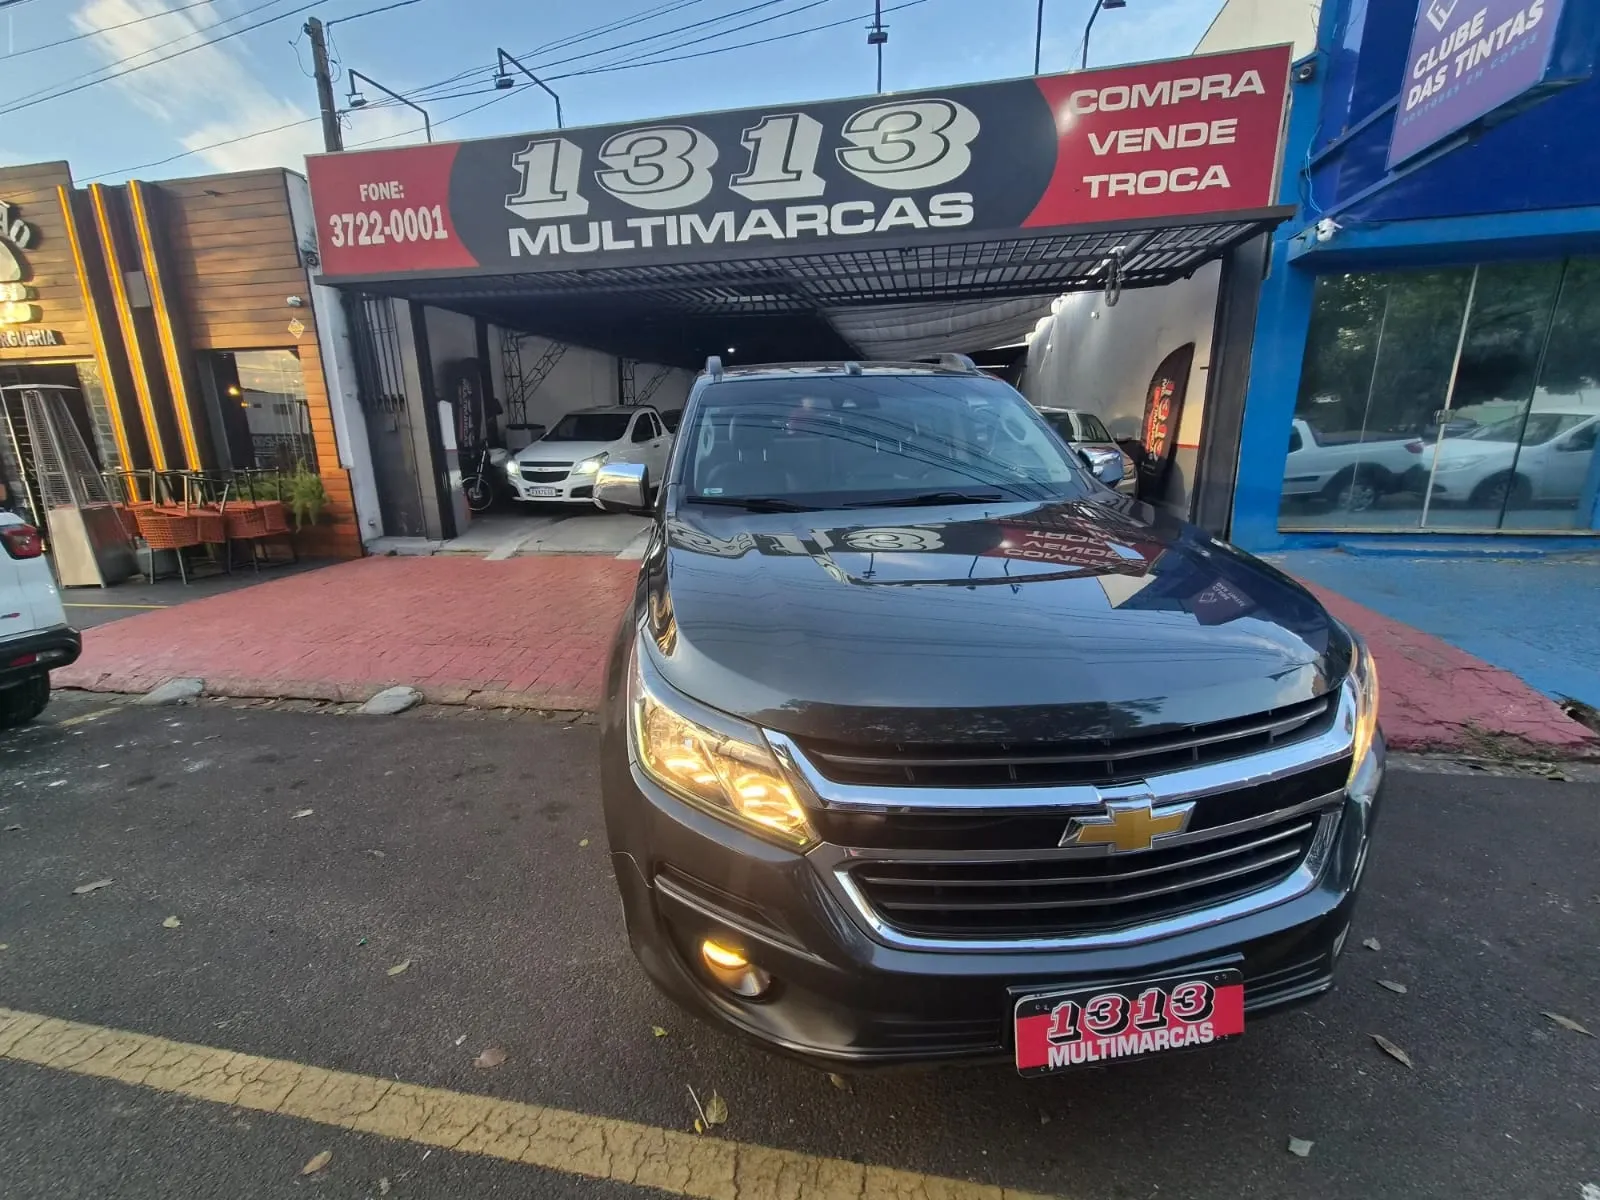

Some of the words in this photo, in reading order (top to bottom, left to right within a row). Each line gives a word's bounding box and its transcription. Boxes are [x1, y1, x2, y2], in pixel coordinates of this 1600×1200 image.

[1406, 64, 1448, 111] DAS
[1455, 0, 1544, 78] TINTAS
[1413, 7, 1488, 79] CLUBE
[1069, 69, 1266, 115] COMPRA
[504, 98, 981, 220] 1313
[1088, 118, 1238, 156] VENDE
[359, 181, 404, 202] FONE:
[1082, 165, 1231, 199] TROCA
[329, 204, 448, 248] 3722-0001
[507, 192, 975, 257] MULTIMARCAS
[1047, 980, 1216, 1046] 1313
[1048, 1021, 1216, 1070] MULTIMARCAS
